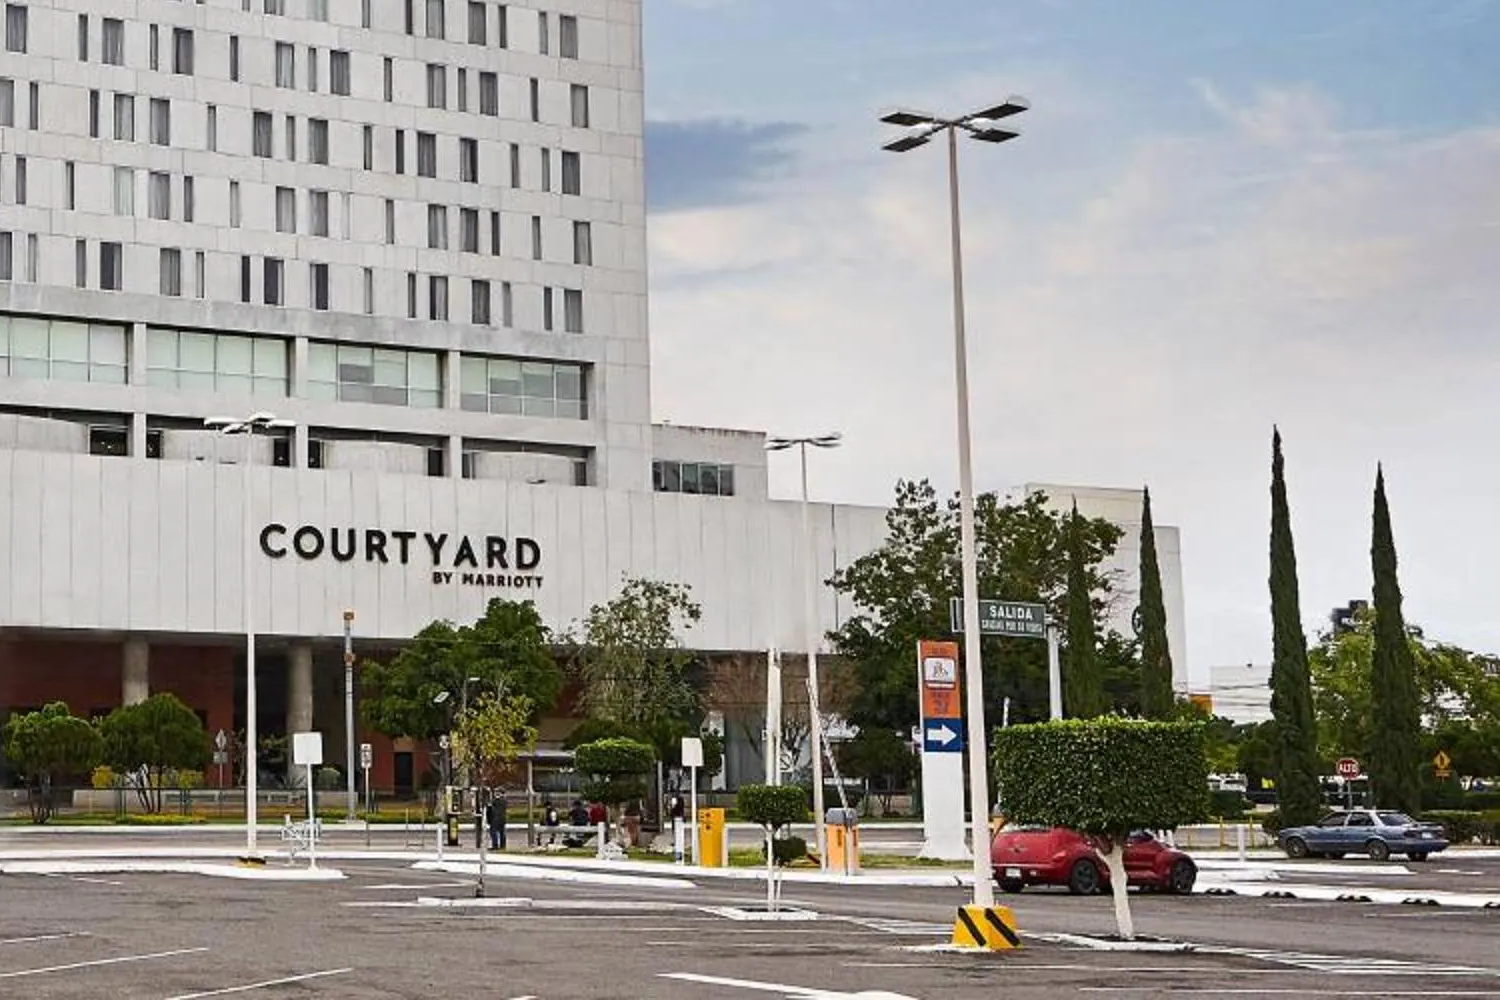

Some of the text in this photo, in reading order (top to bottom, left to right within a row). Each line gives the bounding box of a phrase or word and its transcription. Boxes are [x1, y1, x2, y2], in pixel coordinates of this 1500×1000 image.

[259, 523, 542, 570] COURTYARD
[432, 571, 544, 588] BY MARRIOTT
[989, 605, 1033, 620] SALIDA
